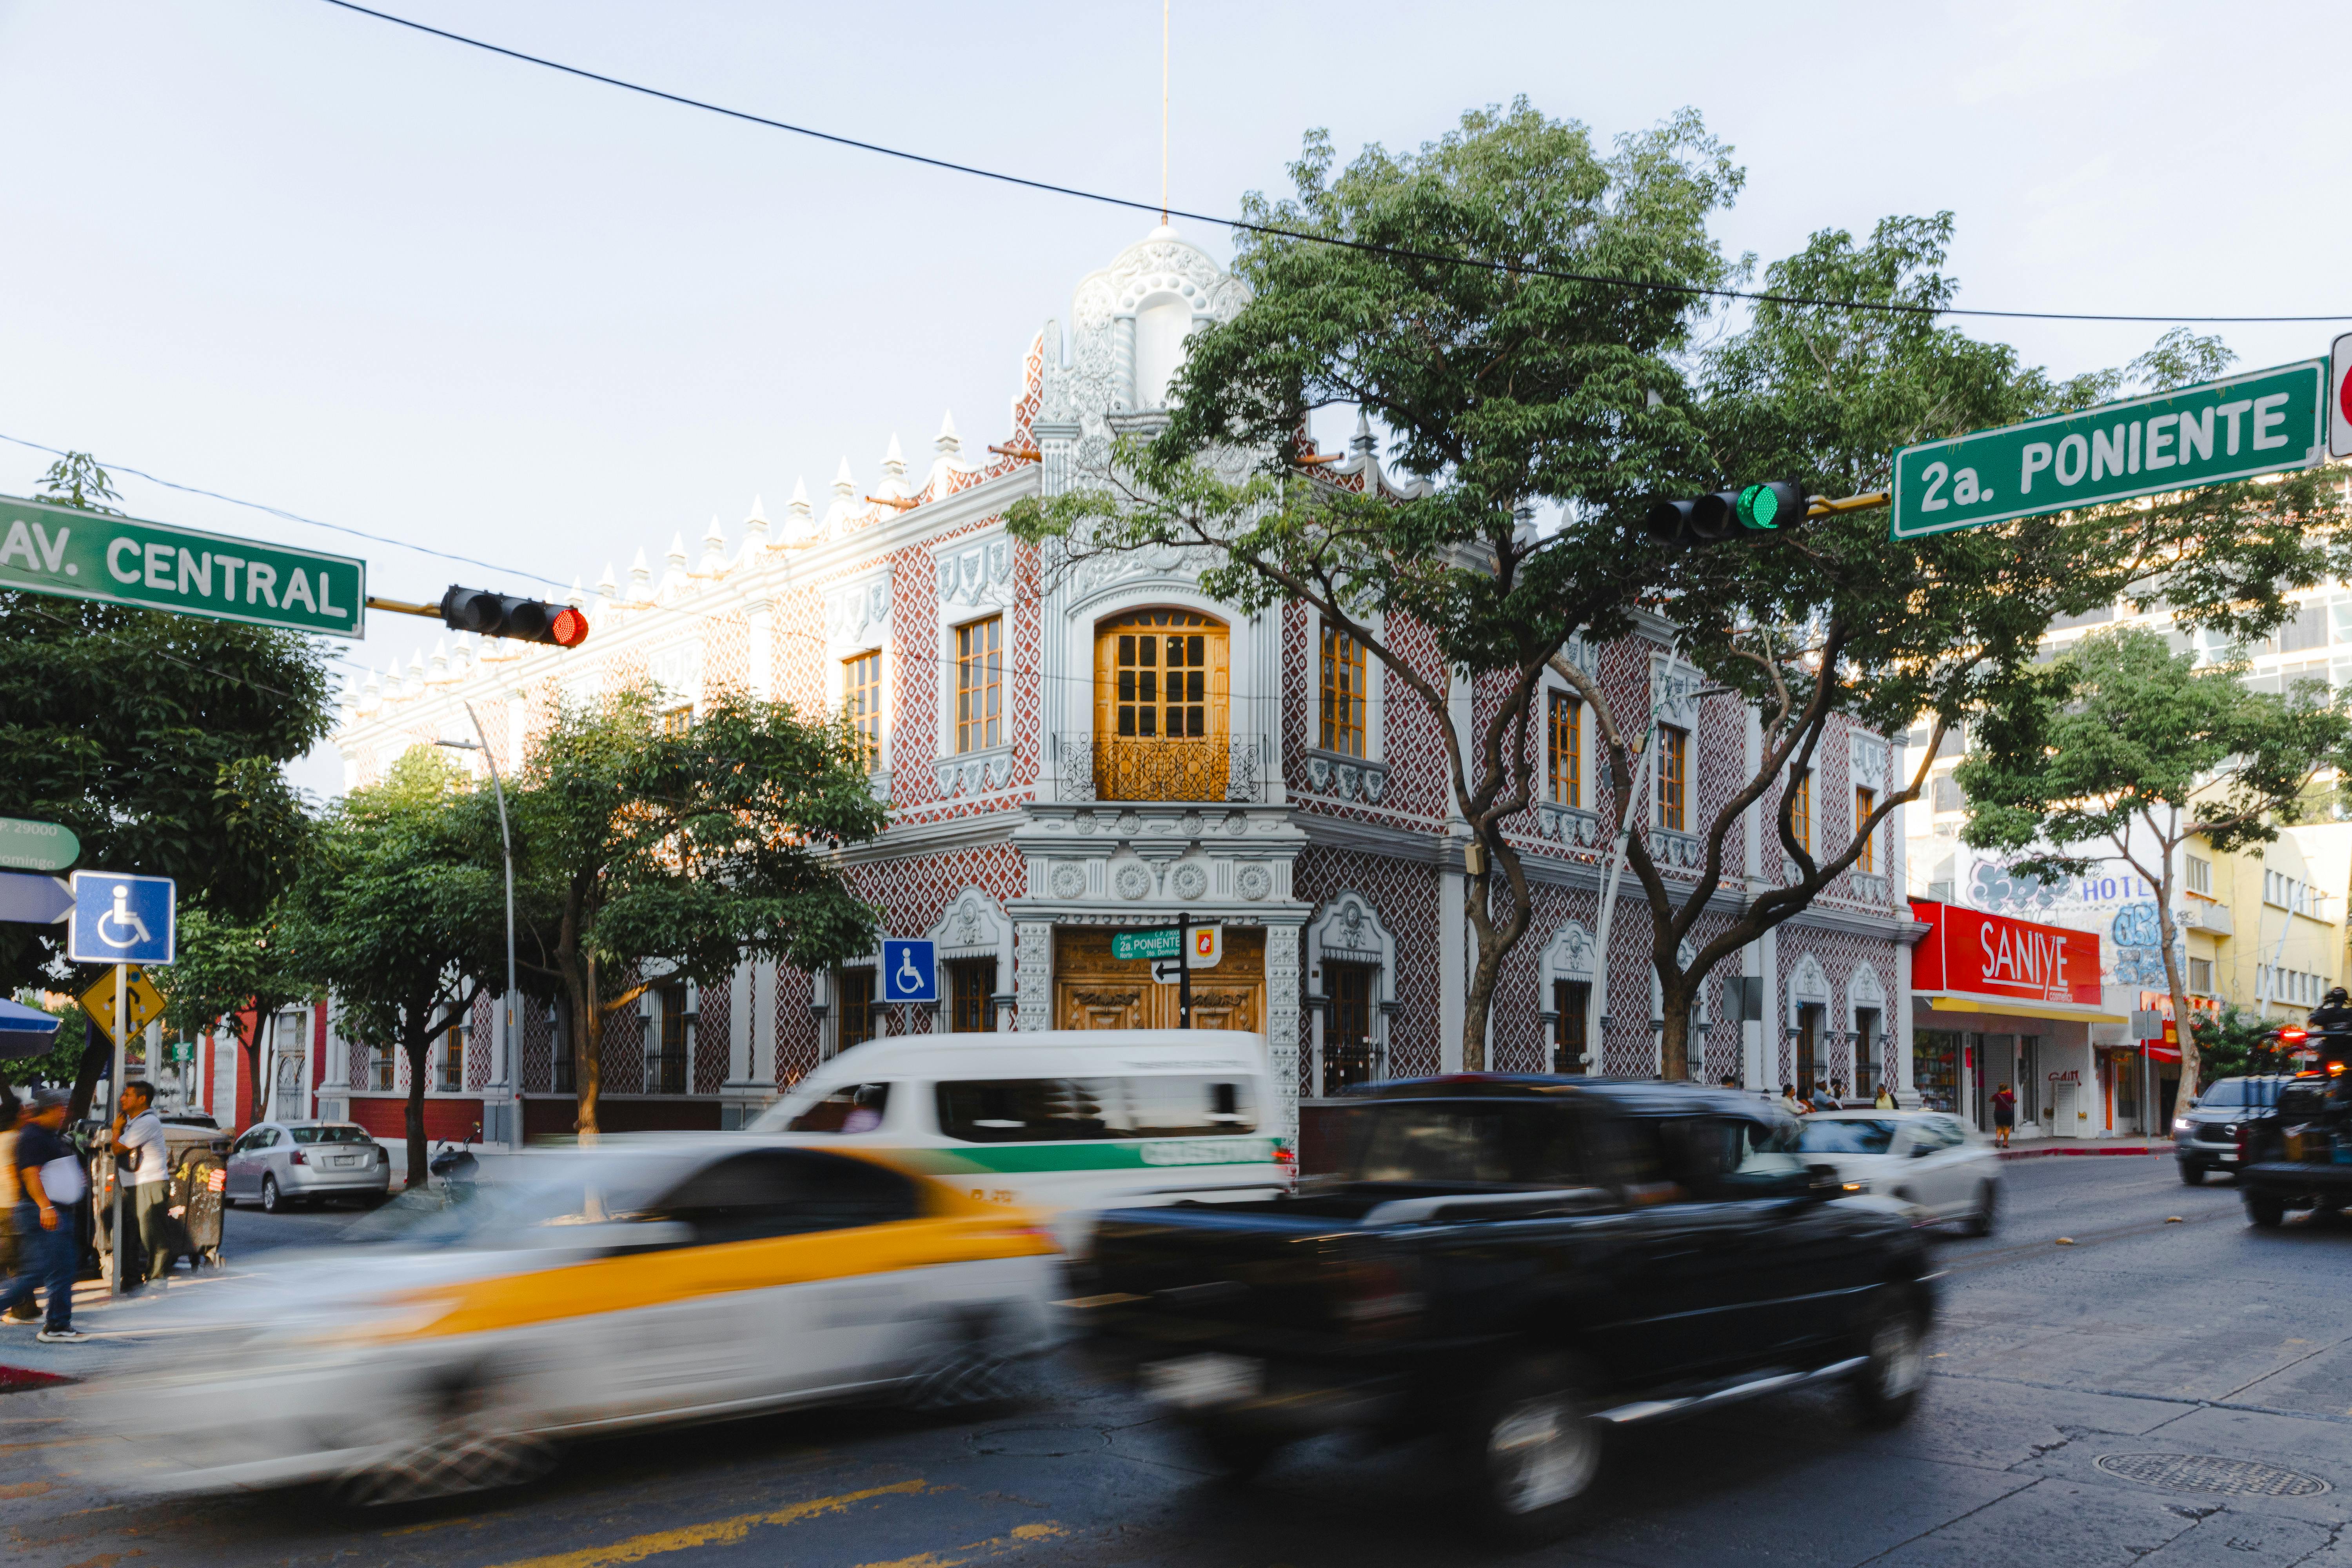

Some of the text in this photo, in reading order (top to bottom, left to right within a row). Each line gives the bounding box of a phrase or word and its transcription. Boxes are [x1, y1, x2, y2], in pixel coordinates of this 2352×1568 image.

[1922, 393, 2289, 512] 2a. PONIENTE
[0, 520, 347, 618] AV. CENTRAL
[15, 821, 57, 837] 29000
[1120, 937, 1180, 952] 2a. PONIENTE
[1981, 921, 2068, 1001] SANIYE
